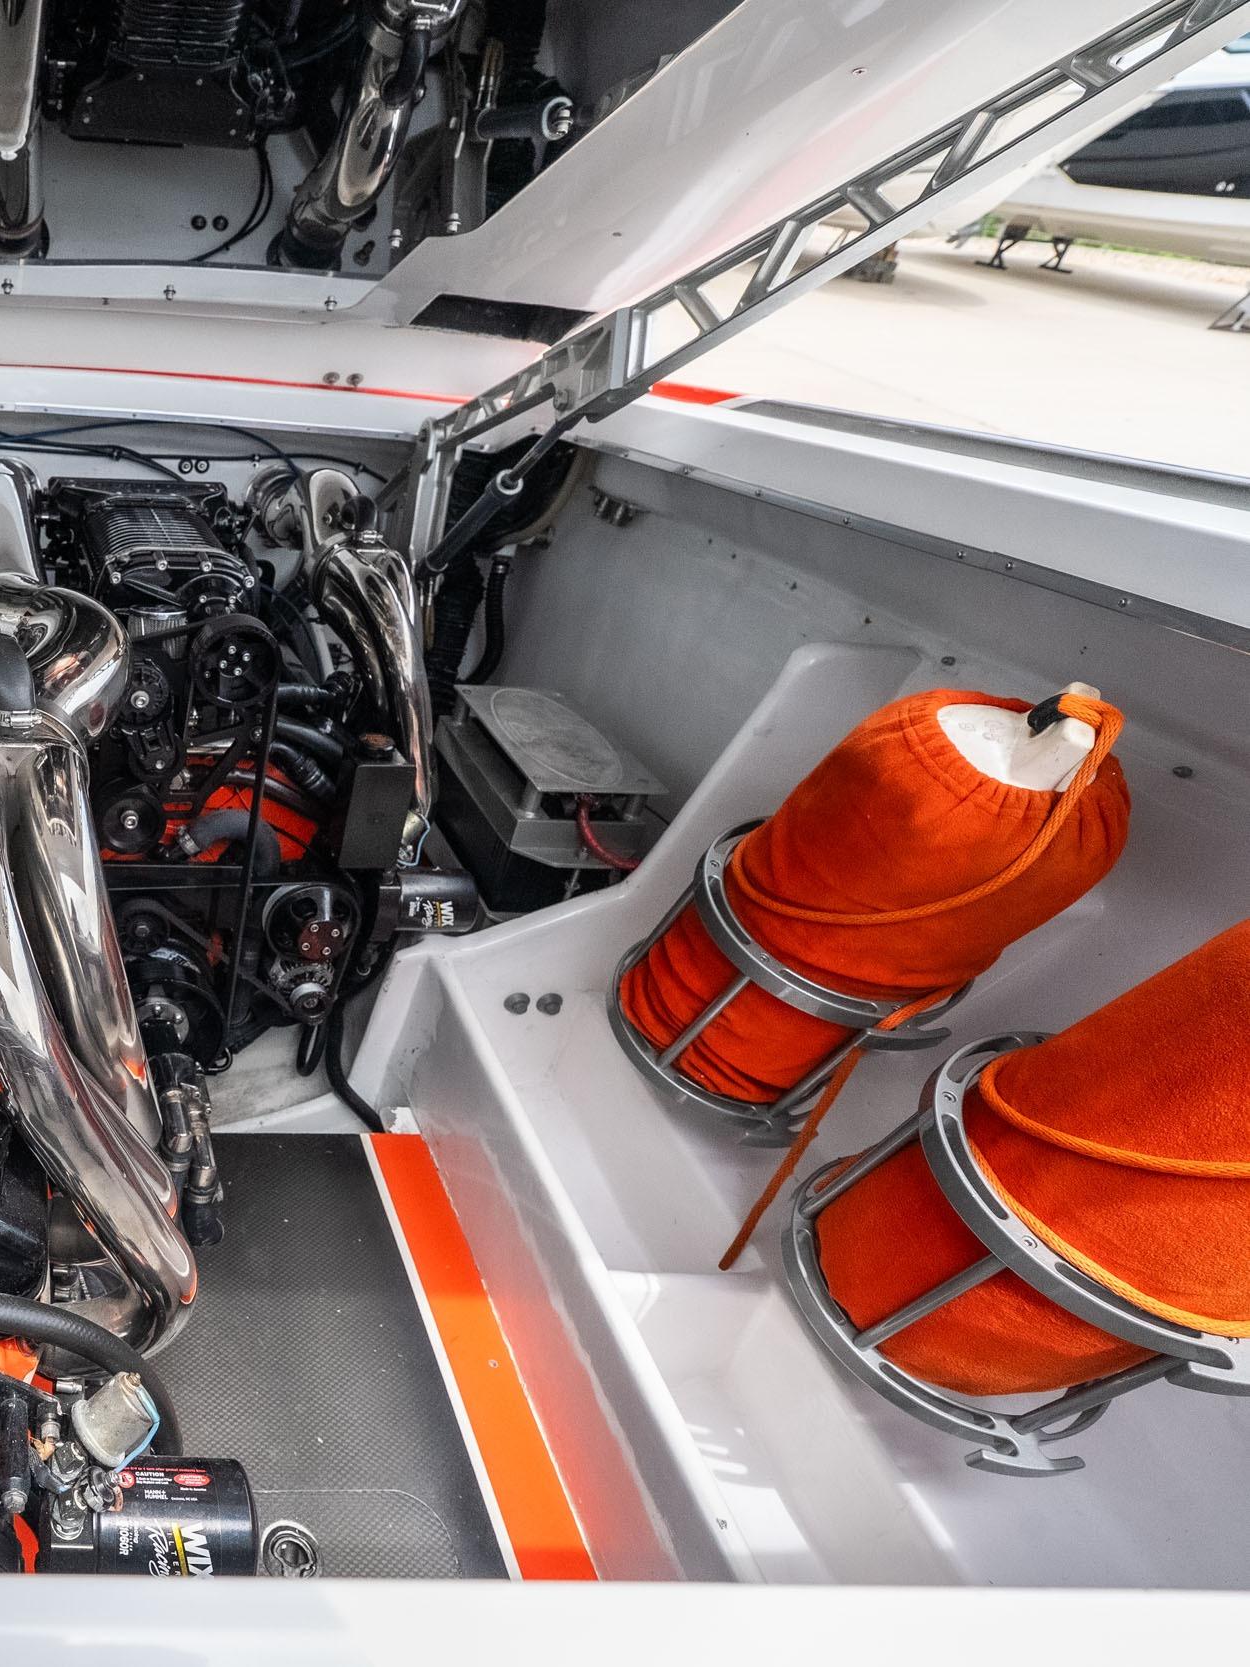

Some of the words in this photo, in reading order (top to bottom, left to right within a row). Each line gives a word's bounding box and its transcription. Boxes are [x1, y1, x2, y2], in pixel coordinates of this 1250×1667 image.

[440, 901, 454, 926] WIX
[119, 1520, 129, 1556] 1060R
[180, 1522, 214, 1577] WIX
